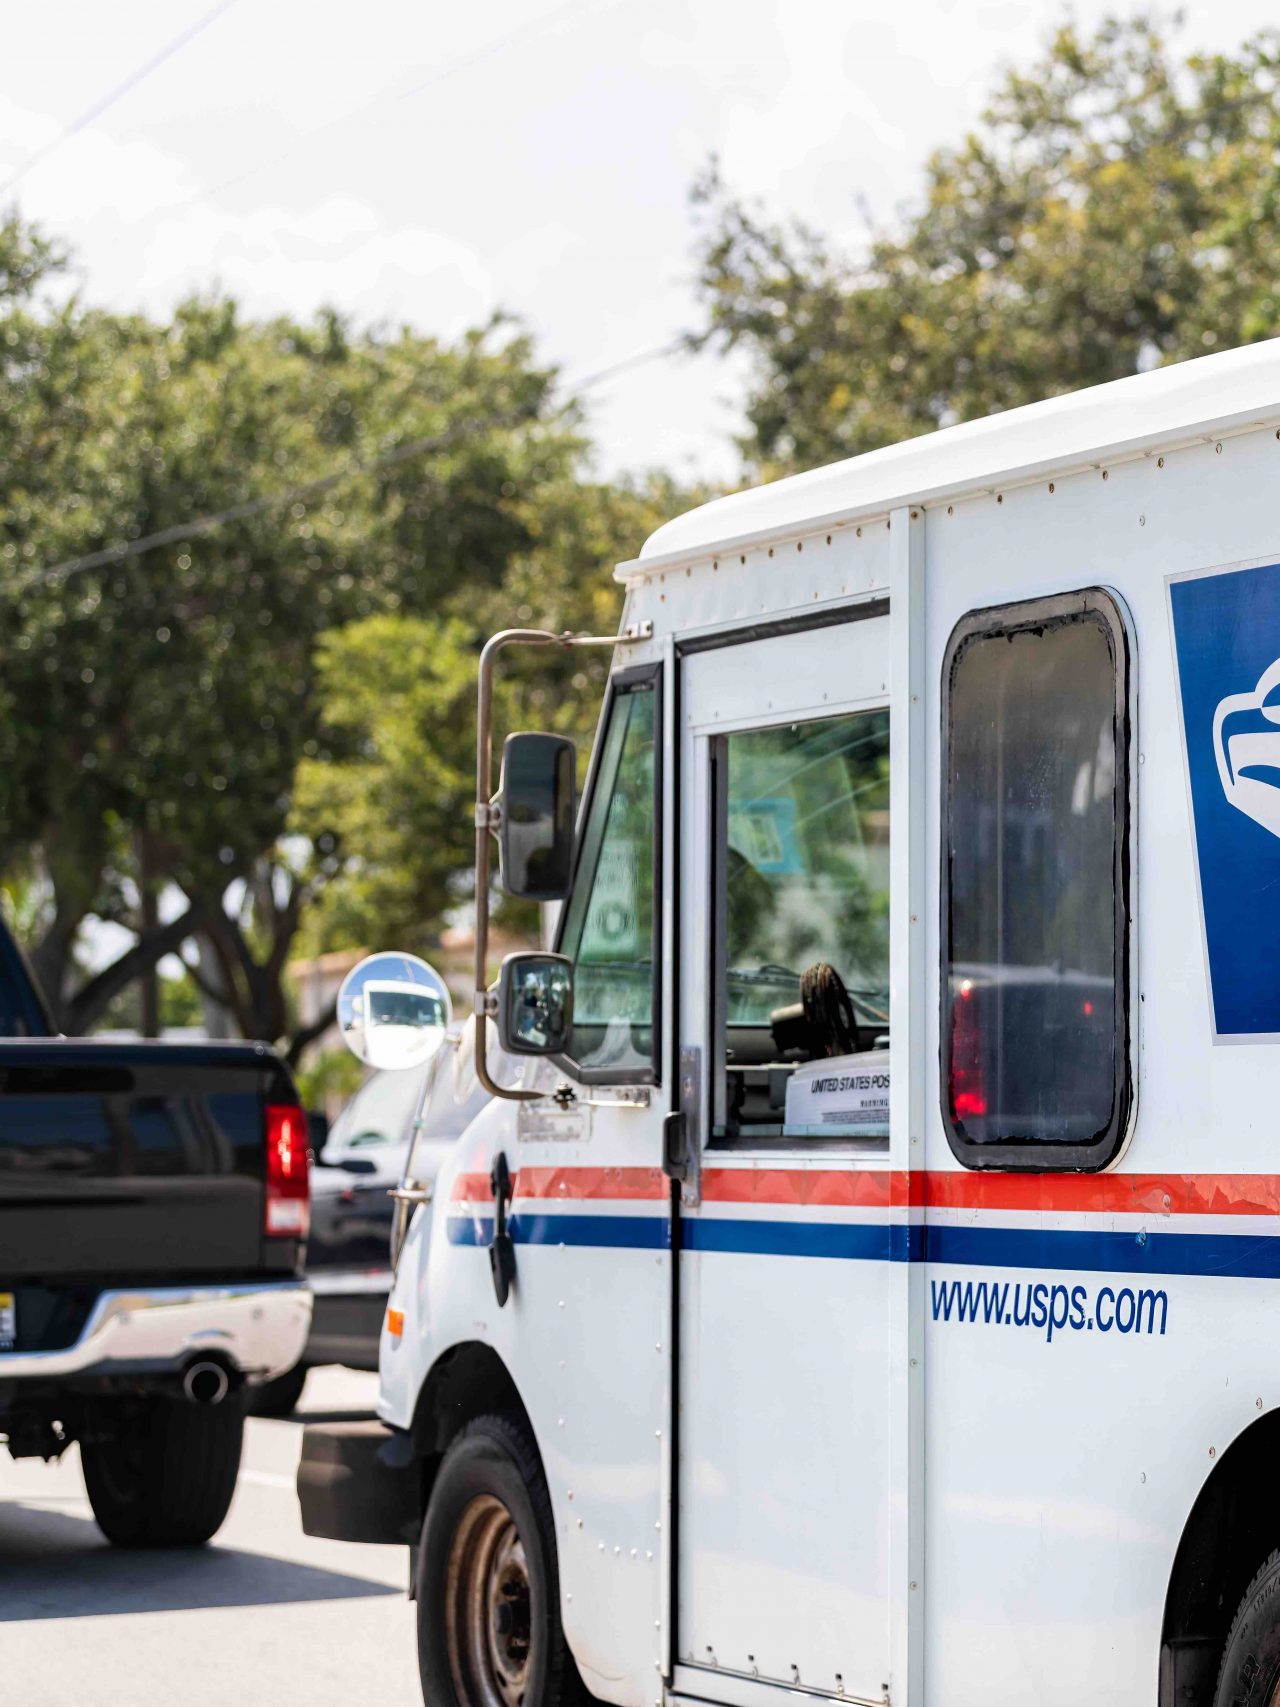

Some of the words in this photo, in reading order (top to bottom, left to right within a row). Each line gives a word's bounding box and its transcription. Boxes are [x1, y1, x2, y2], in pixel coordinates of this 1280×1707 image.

[811, 1078, 838, 1093] UNITED
[839, 1076, 870, 1091] STATES
[930, 1280, 1169, 1343] www.usps.com
